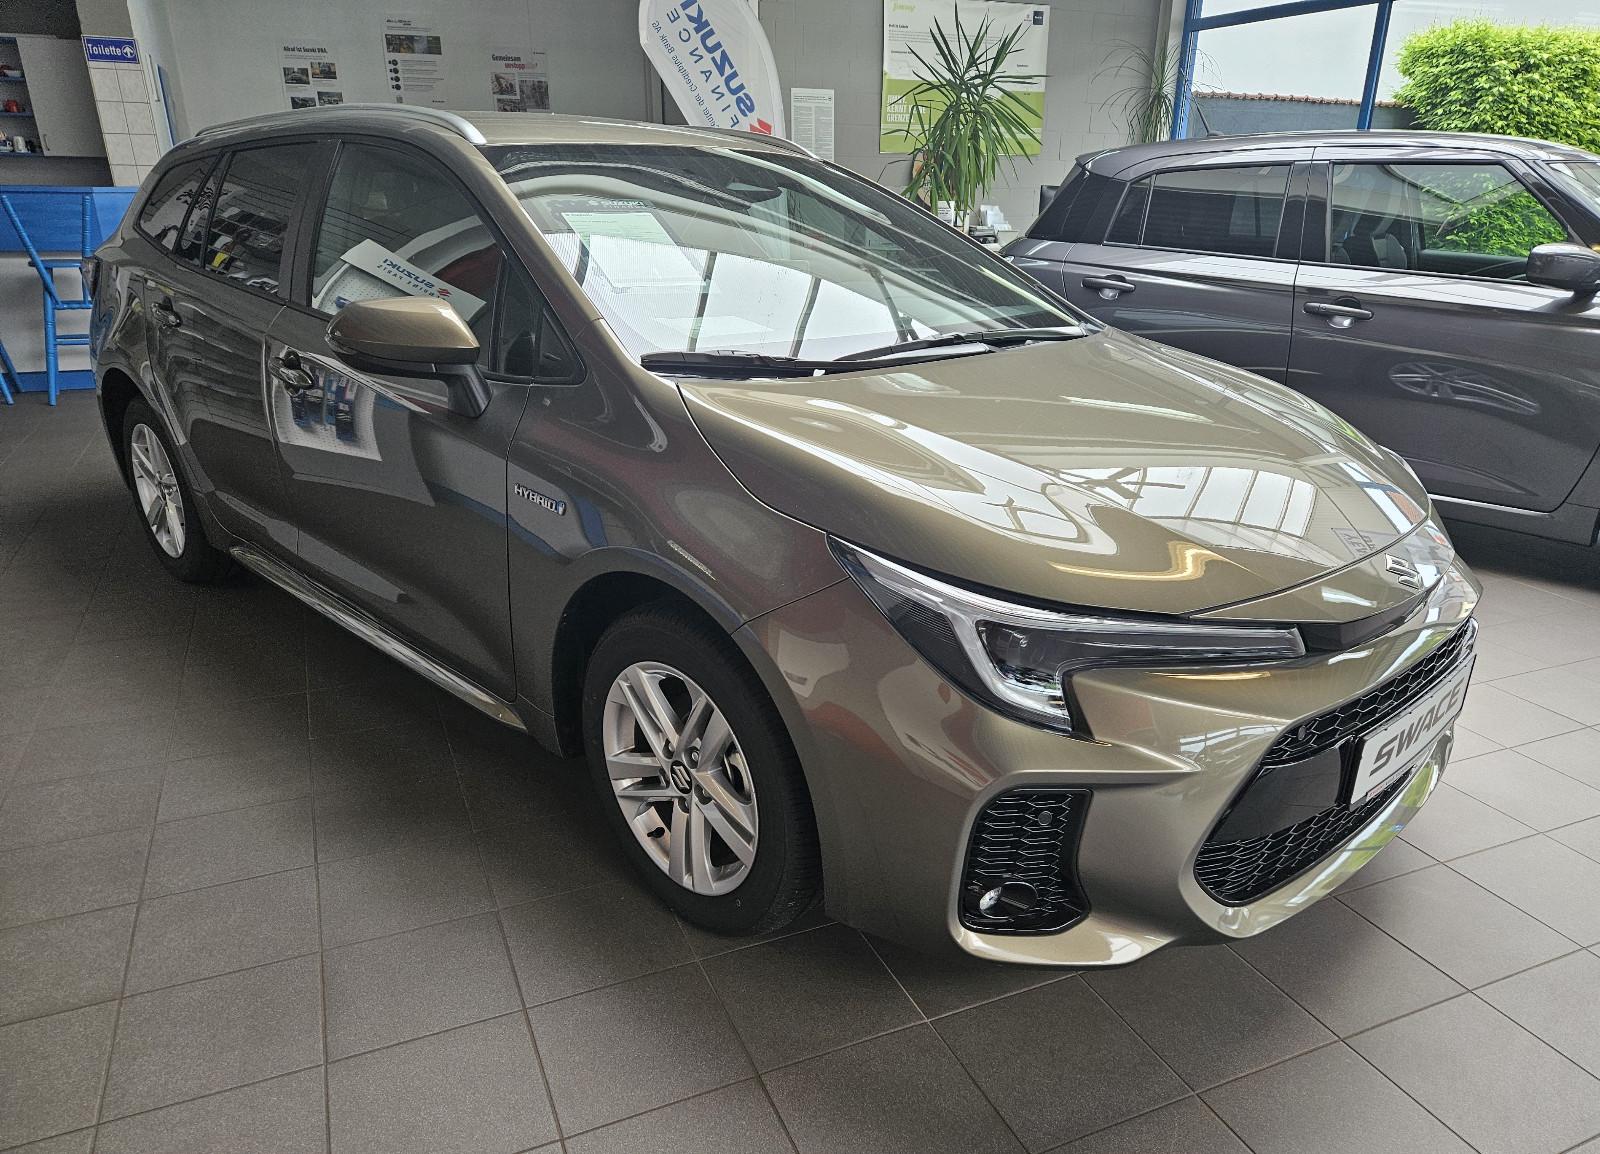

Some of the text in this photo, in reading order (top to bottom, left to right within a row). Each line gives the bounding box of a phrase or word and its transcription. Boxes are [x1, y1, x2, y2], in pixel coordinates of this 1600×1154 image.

[87, 43, 122, 56] Toilette
[491, 53, 521, 62] Gemeinsam
[514, 483, 557, 513] HYBRID
[1368, 676, 1466, 777] SWACE
